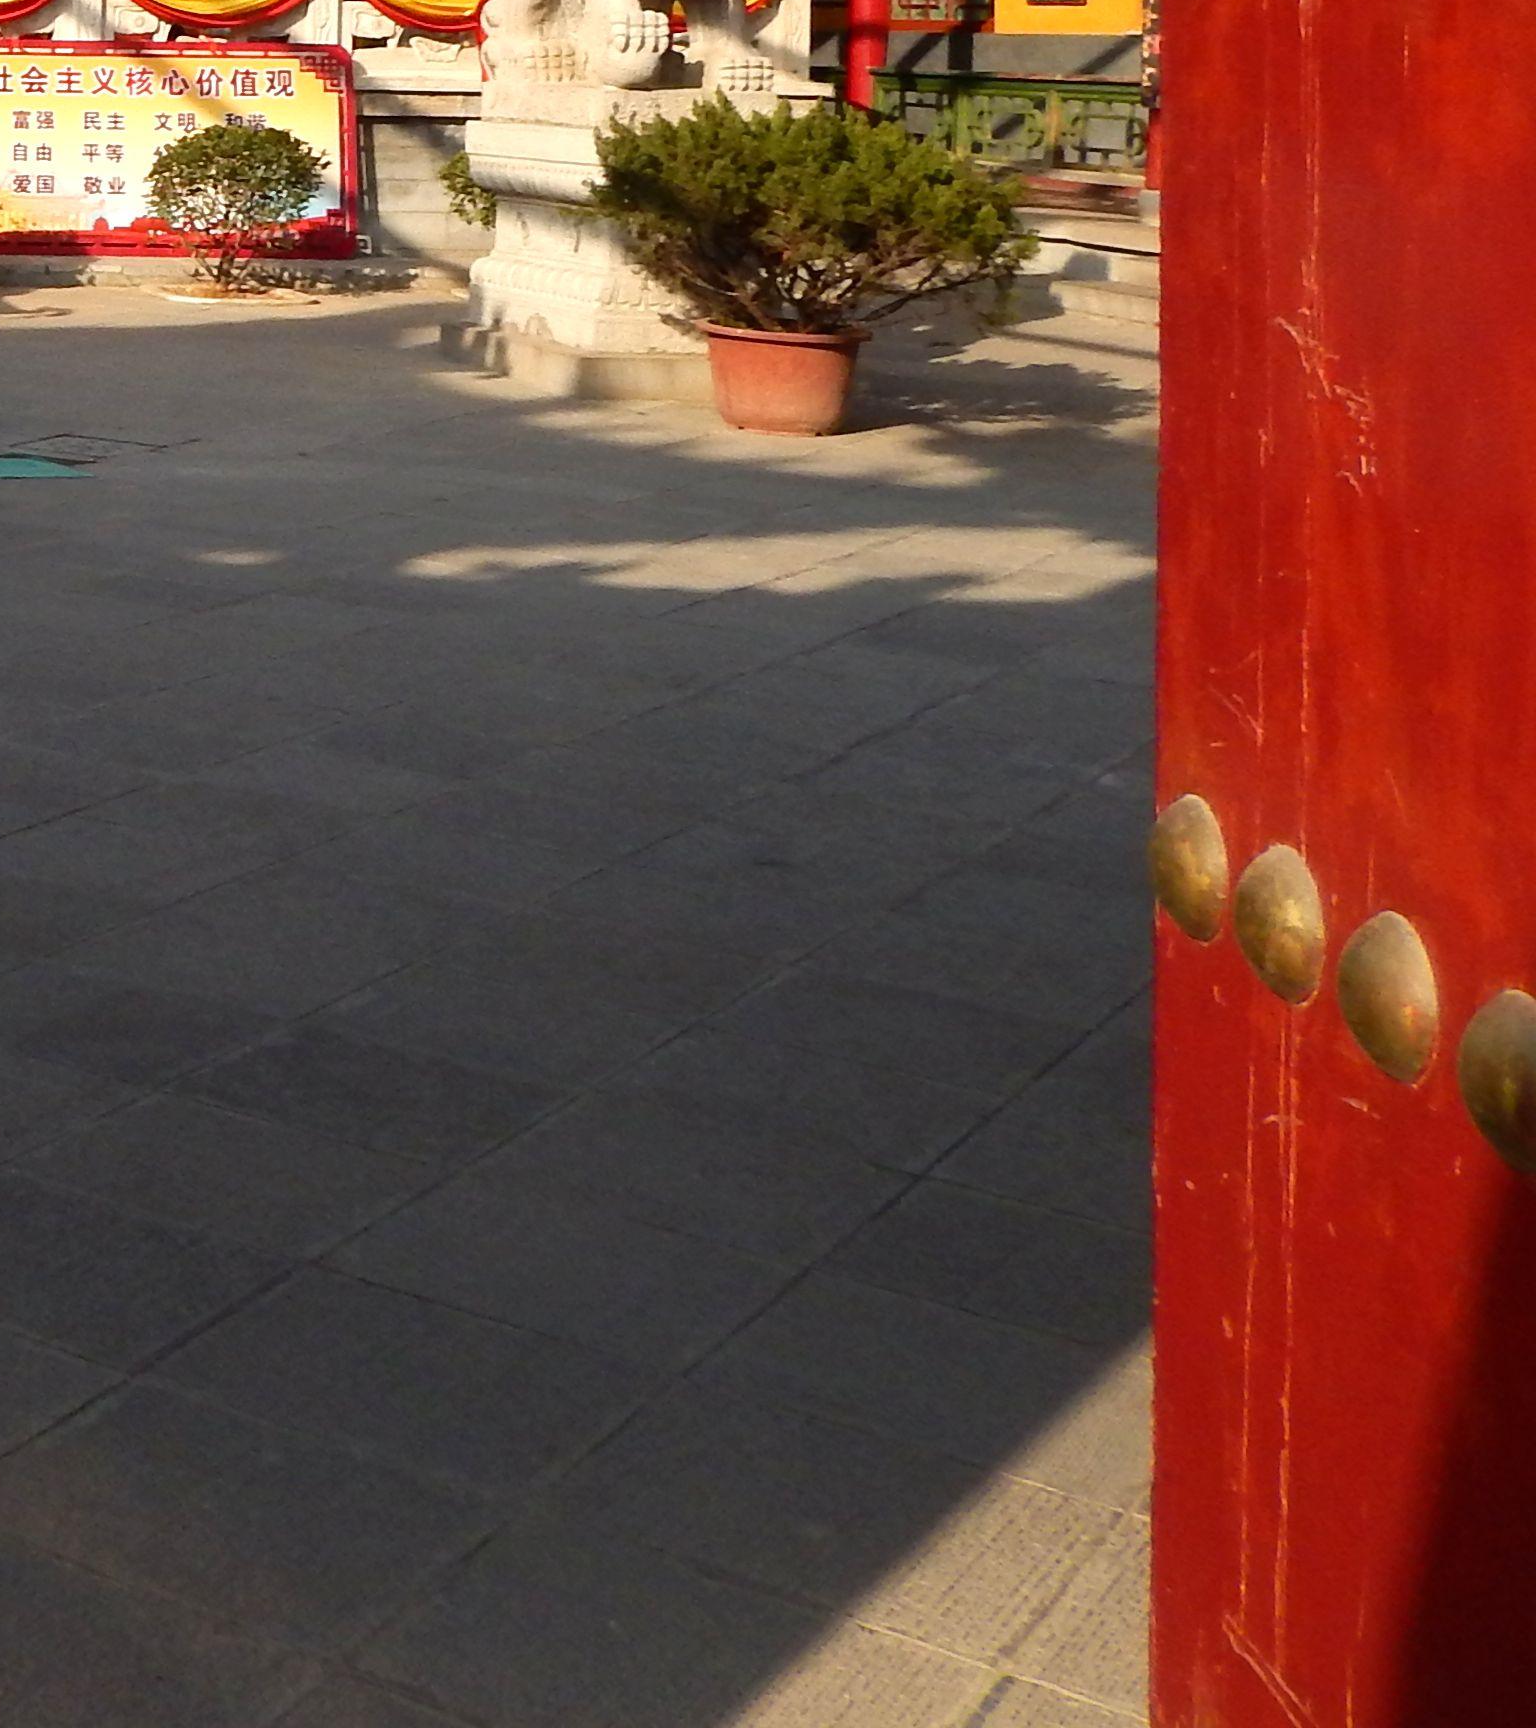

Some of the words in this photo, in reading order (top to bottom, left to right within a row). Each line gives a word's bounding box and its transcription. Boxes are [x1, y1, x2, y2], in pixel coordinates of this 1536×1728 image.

[12, 110, 55, 130] 富强
[83, 112, 126, 131] 民主
[154, 112, 196, 132] 文明
[13, 143, 52, 163] 自由
[82, 144, 124, 163] 平等
[12, 175, 55, 195] 爱国
[83, 176, 126, 195] 敬业
